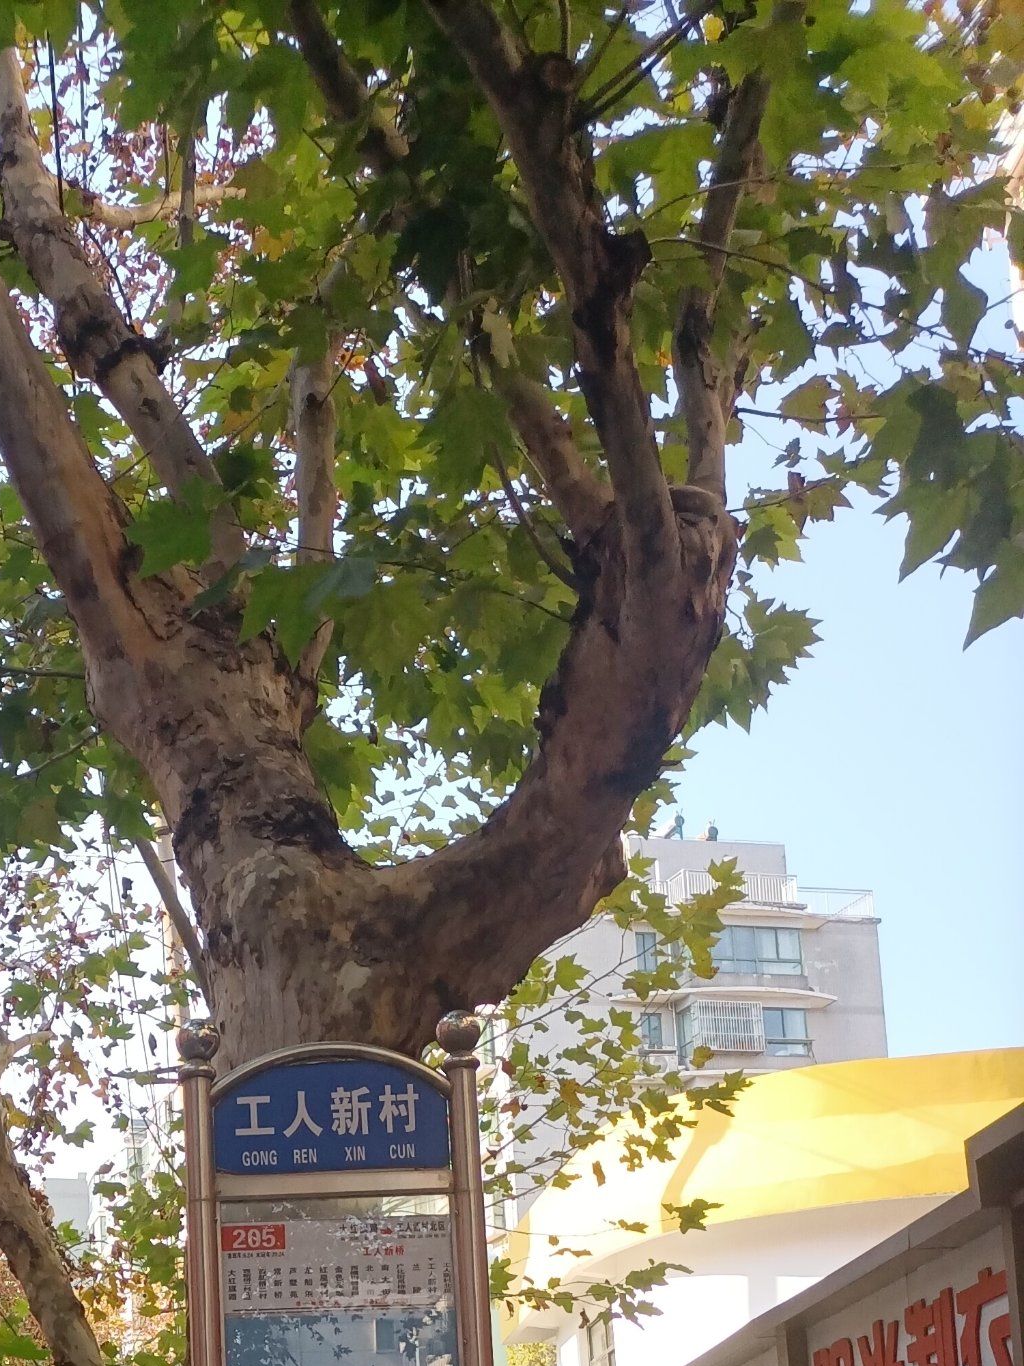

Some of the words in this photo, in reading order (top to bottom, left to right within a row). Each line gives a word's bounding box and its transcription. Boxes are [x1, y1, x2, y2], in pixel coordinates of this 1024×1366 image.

[235, 1084, 419, 1138] 工人新村
[242, 1150, 278, 1167] GONG
[293, 1148, 318, 1164] REN
[345, 1146, 366, 1162] XIN
[389, 1143, 416, 1160] CUN
[232, 1228, 276, 1249] 205
